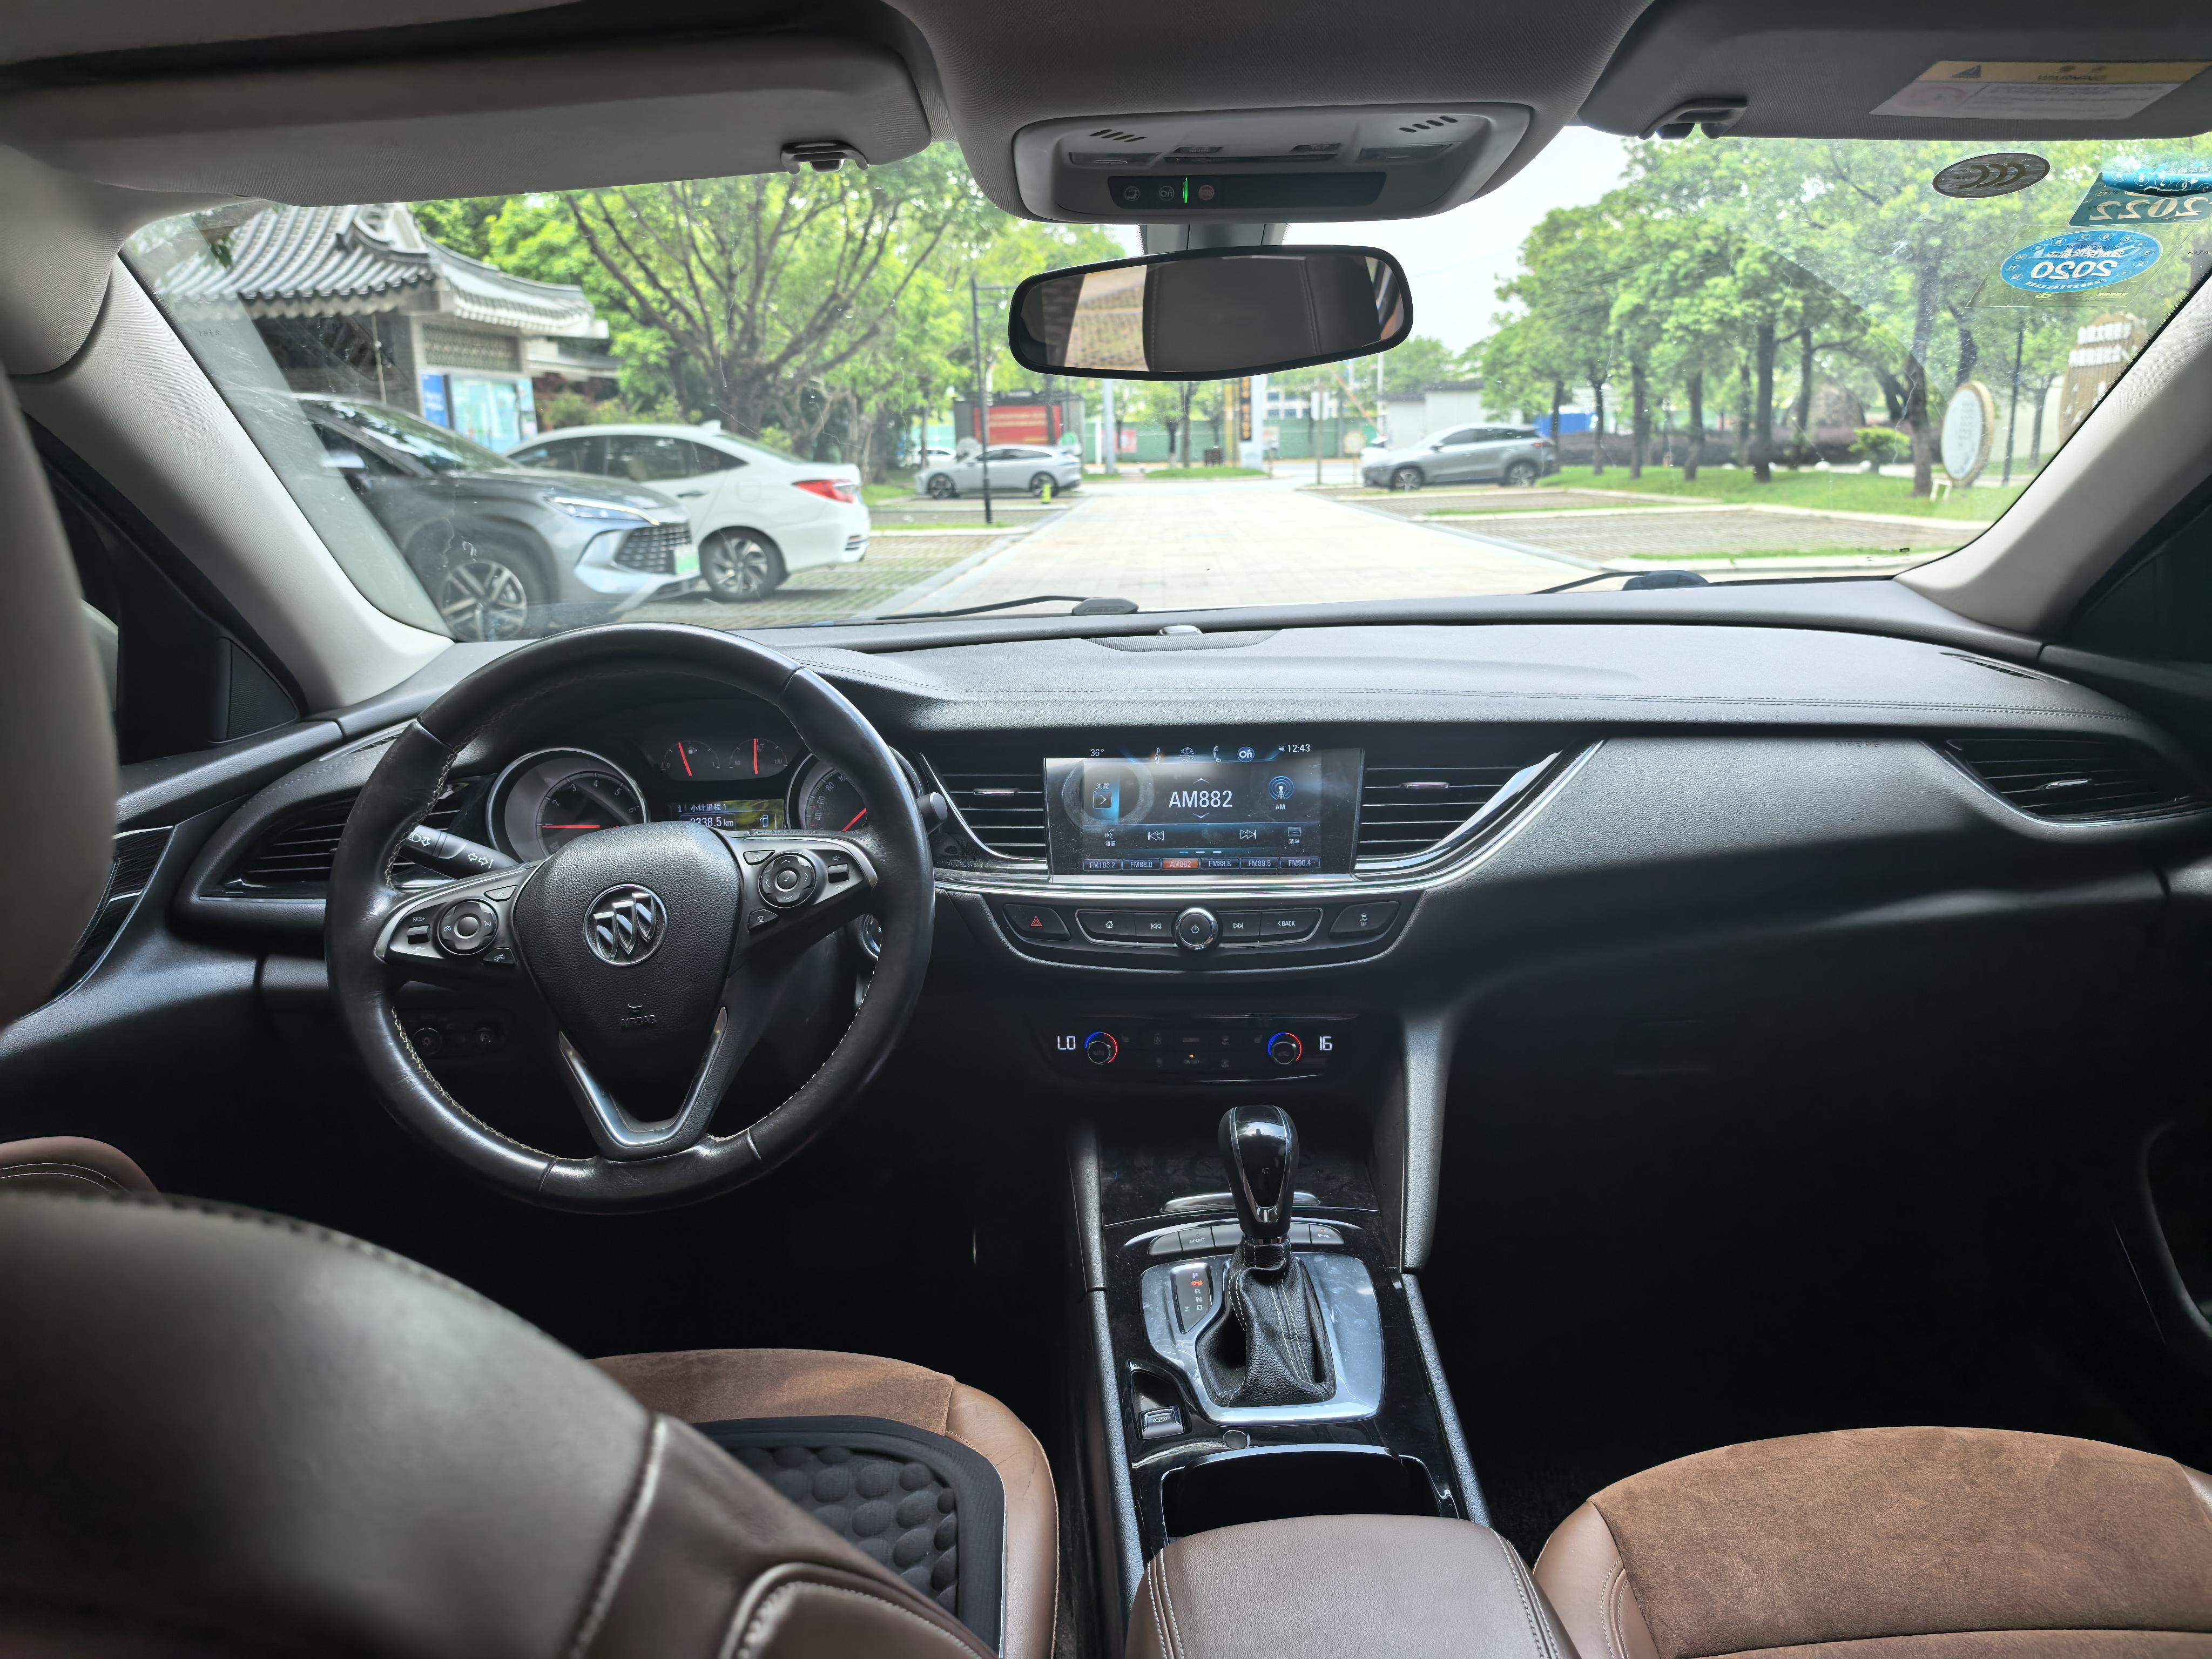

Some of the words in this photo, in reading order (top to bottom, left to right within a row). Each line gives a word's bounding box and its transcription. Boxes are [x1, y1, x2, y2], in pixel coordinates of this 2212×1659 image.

[1287, 744, 1310, 752] 12:43
[593, 779, 598, 788] 4
[825, 781, 835, 791] 80
[615, 788, 622, 796] 5
[817, 795, 826, 805] 60
[1169, 790, 1232, 808] AM882
[690, 803, 722, 813] 小计里程
[814, 812, 822, 821] 40
[724, 819, 734, 827] km
[1319, 1036, 1332, 1051] 16
